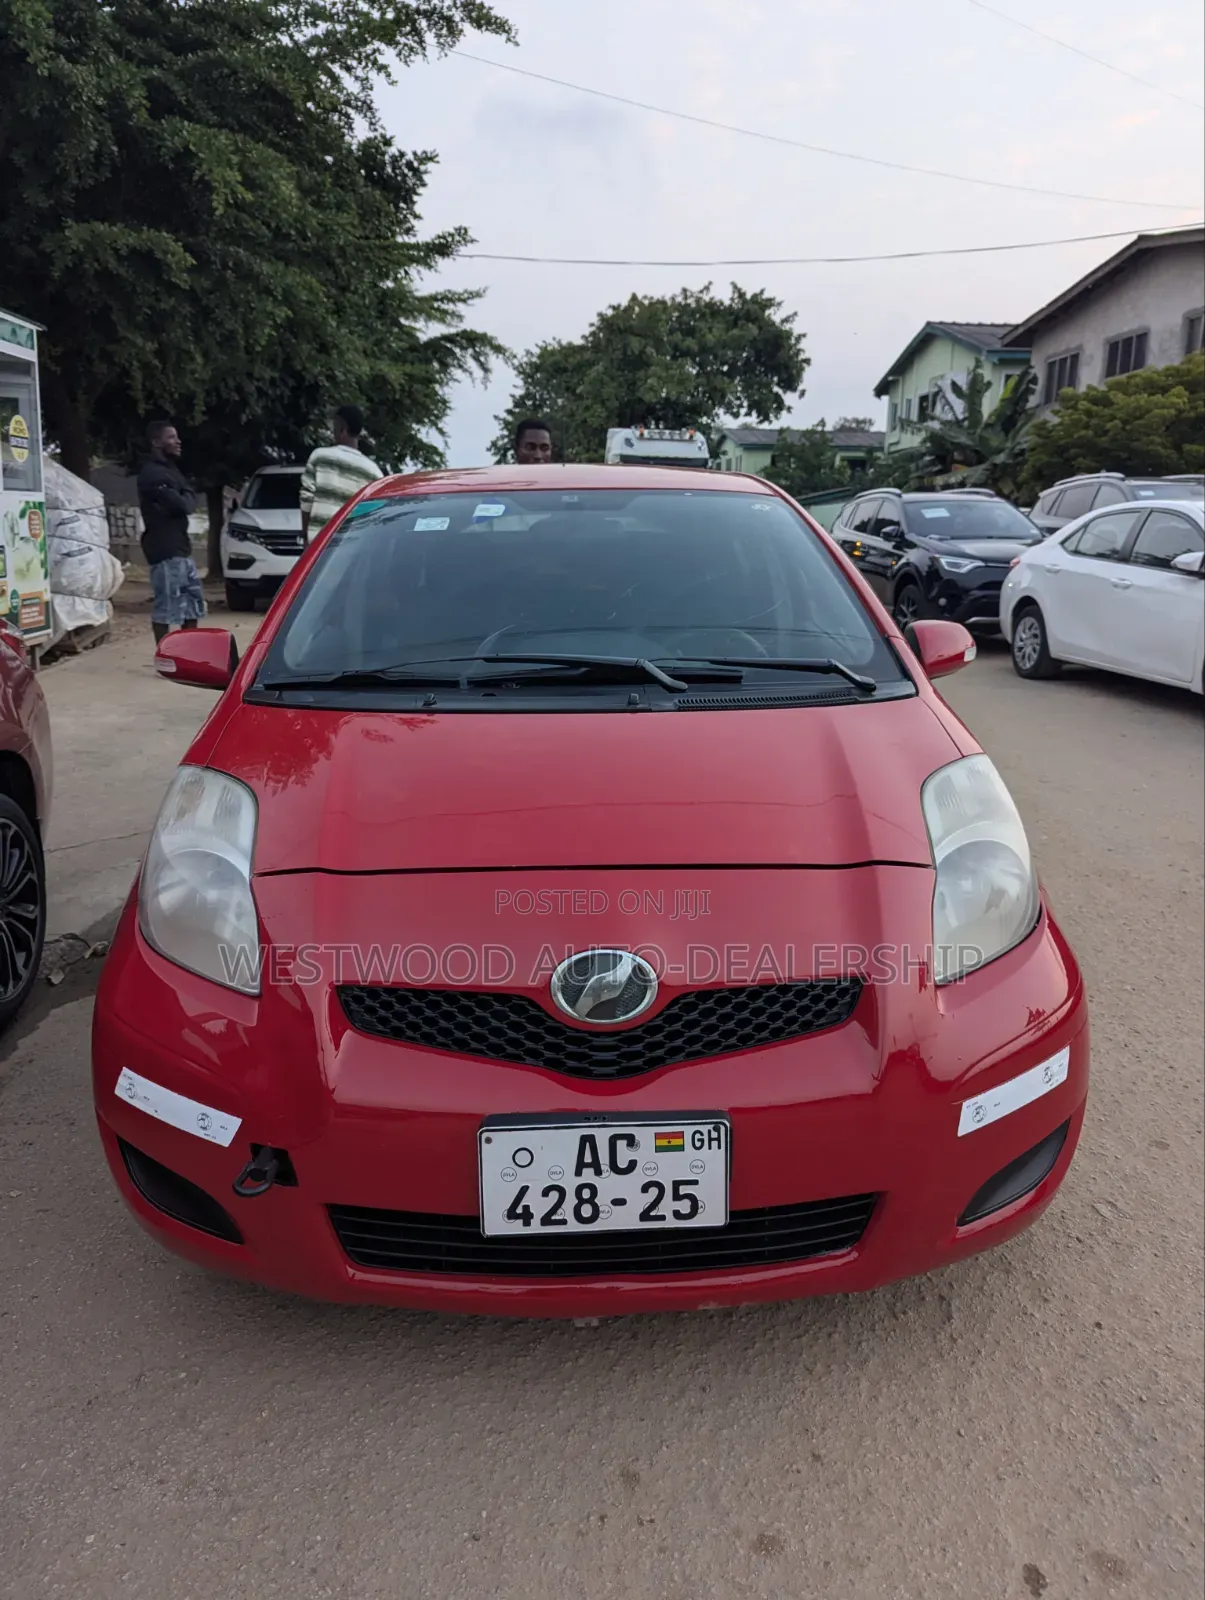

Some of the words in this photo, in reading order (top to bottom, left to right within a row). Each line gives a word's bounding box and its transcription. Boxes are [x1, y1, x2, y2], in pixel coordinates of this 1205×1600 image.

[574, 1132, 638, 1177] AC
[691, 1128, 722, 1151] GH
[506, 1179, 700, 1227] 428-25
